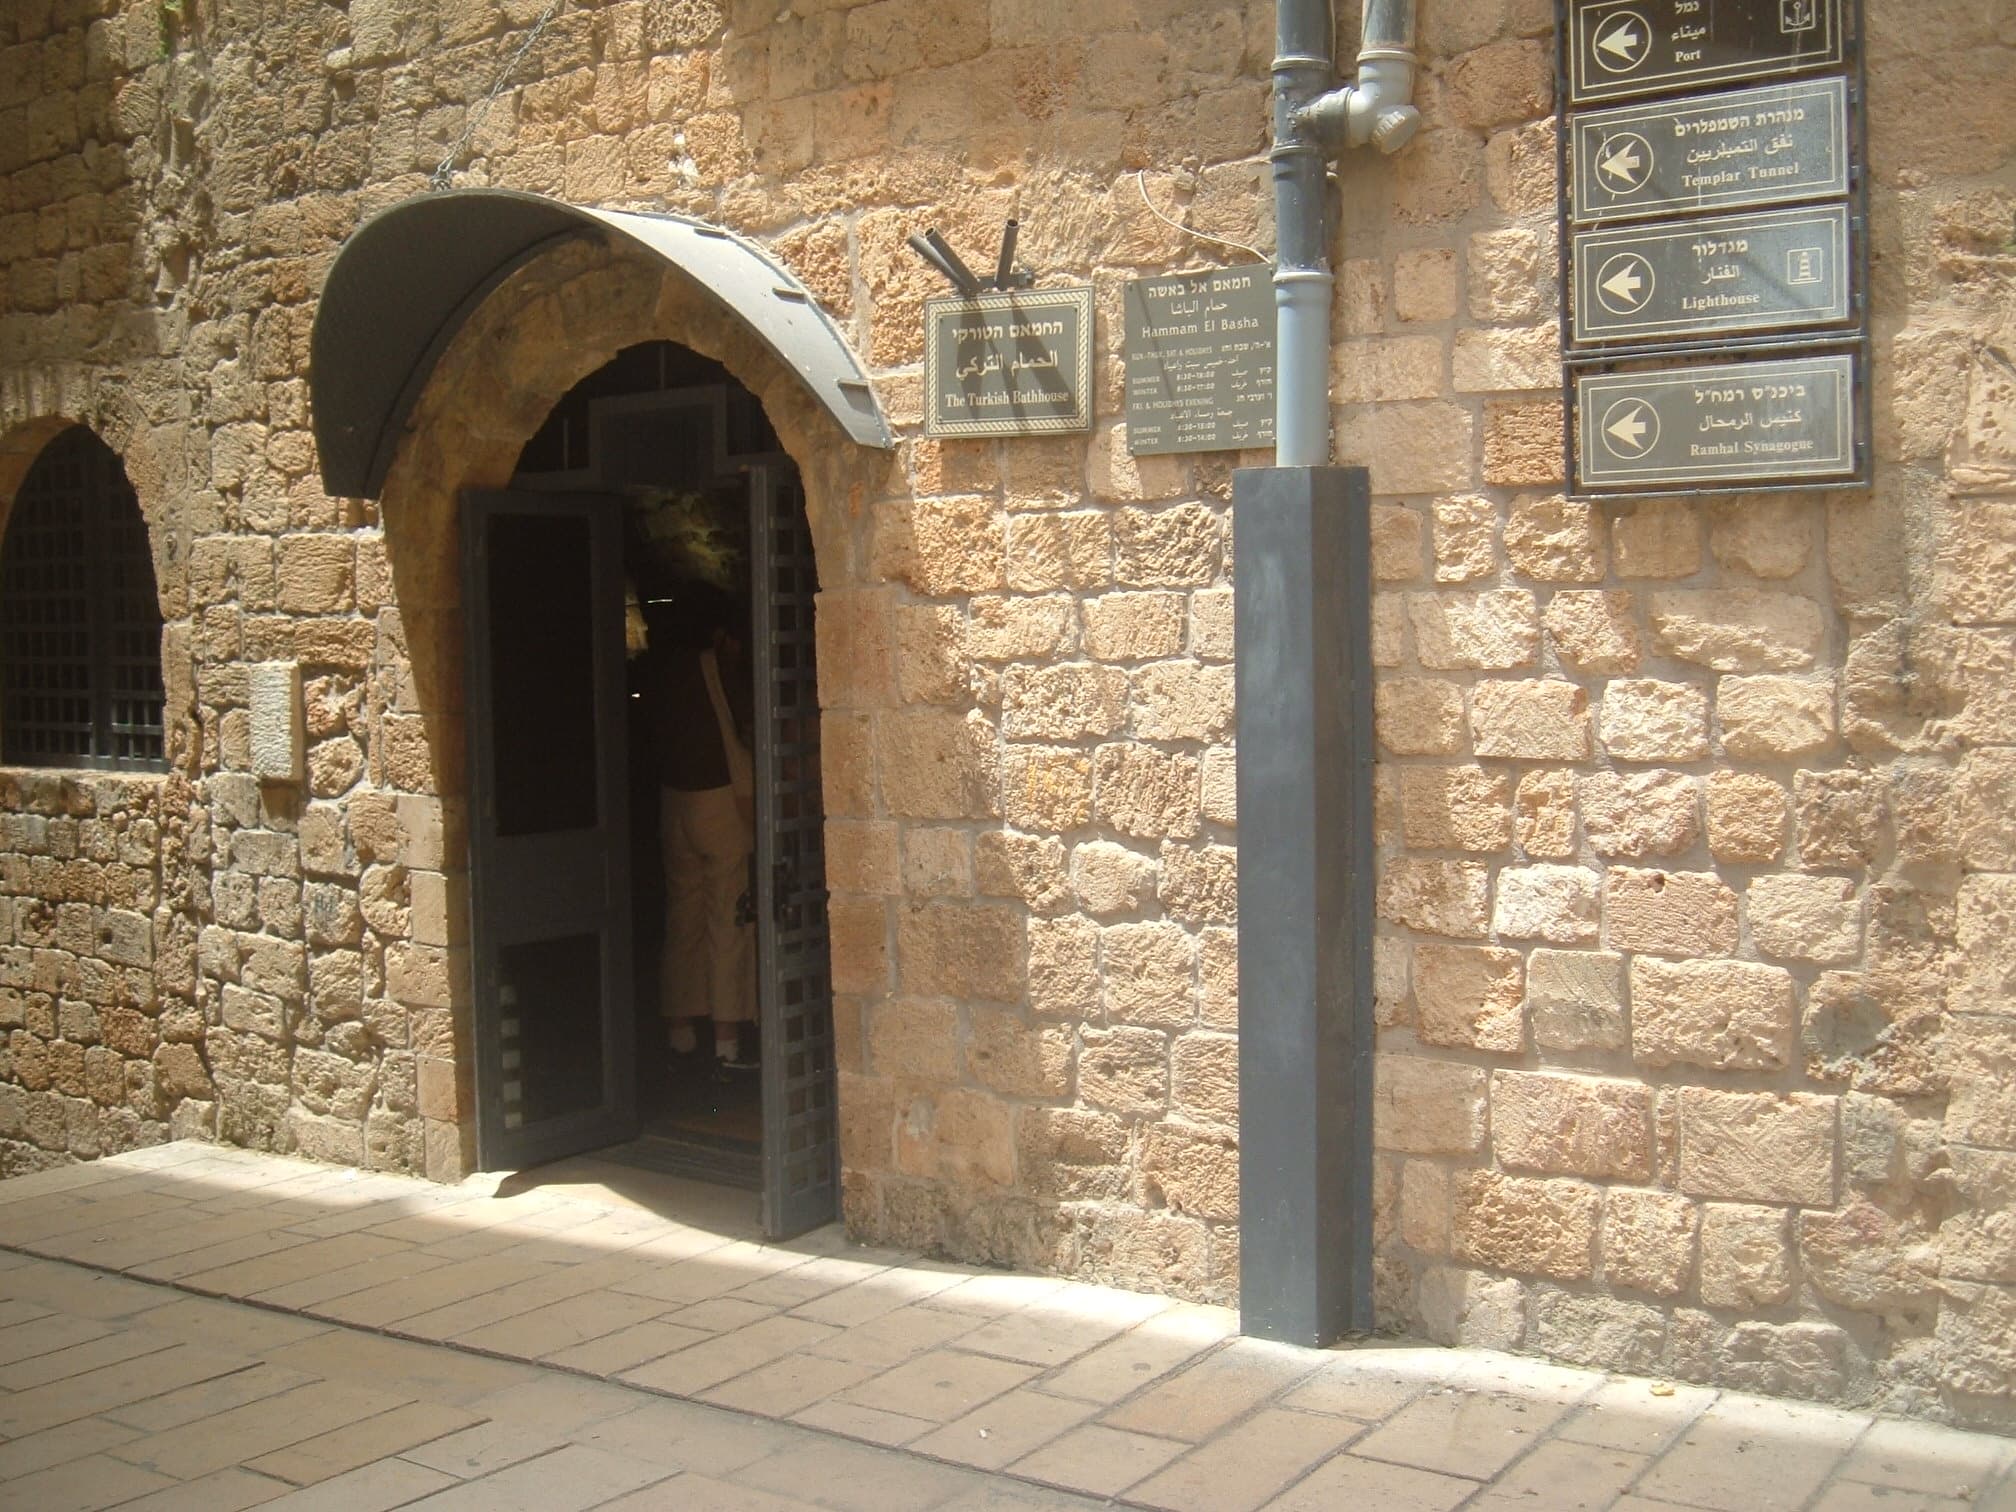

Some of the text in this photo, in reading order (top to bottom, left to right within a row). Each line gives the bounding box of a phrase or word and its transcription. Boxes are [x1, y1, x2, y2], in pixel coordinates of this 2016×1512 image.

[1675, 0, 1700, 14] נמל
[1671, 26, 1706, 42] ميناء
[1674, 50, 1702, 63] Port
[1756, 108, 1804, 126] מנהרת
[1764, 134, 1794, 154] نفق
[1682, 162, 1800, 188] Templar Tunnel
[1692, 240, 1748, 257] מגדלור
[1148, 277, 1251, 298] חמאם אל באשה
[1171, 299, 1228, 318] حمام الباشا
[1682, 293, 1760, 310] Lighthouse
[952, 321, 1063, 344] החמאם הטורקי
[1142, 317, 1259, 338] Hammam El Basha
[955, 350, 1058, 380] الحمام التركي
[945, 389, 1069, 408] The Turkish Bathhouse
[1690, 439, 1814, 456] Ramhal Synagogue
